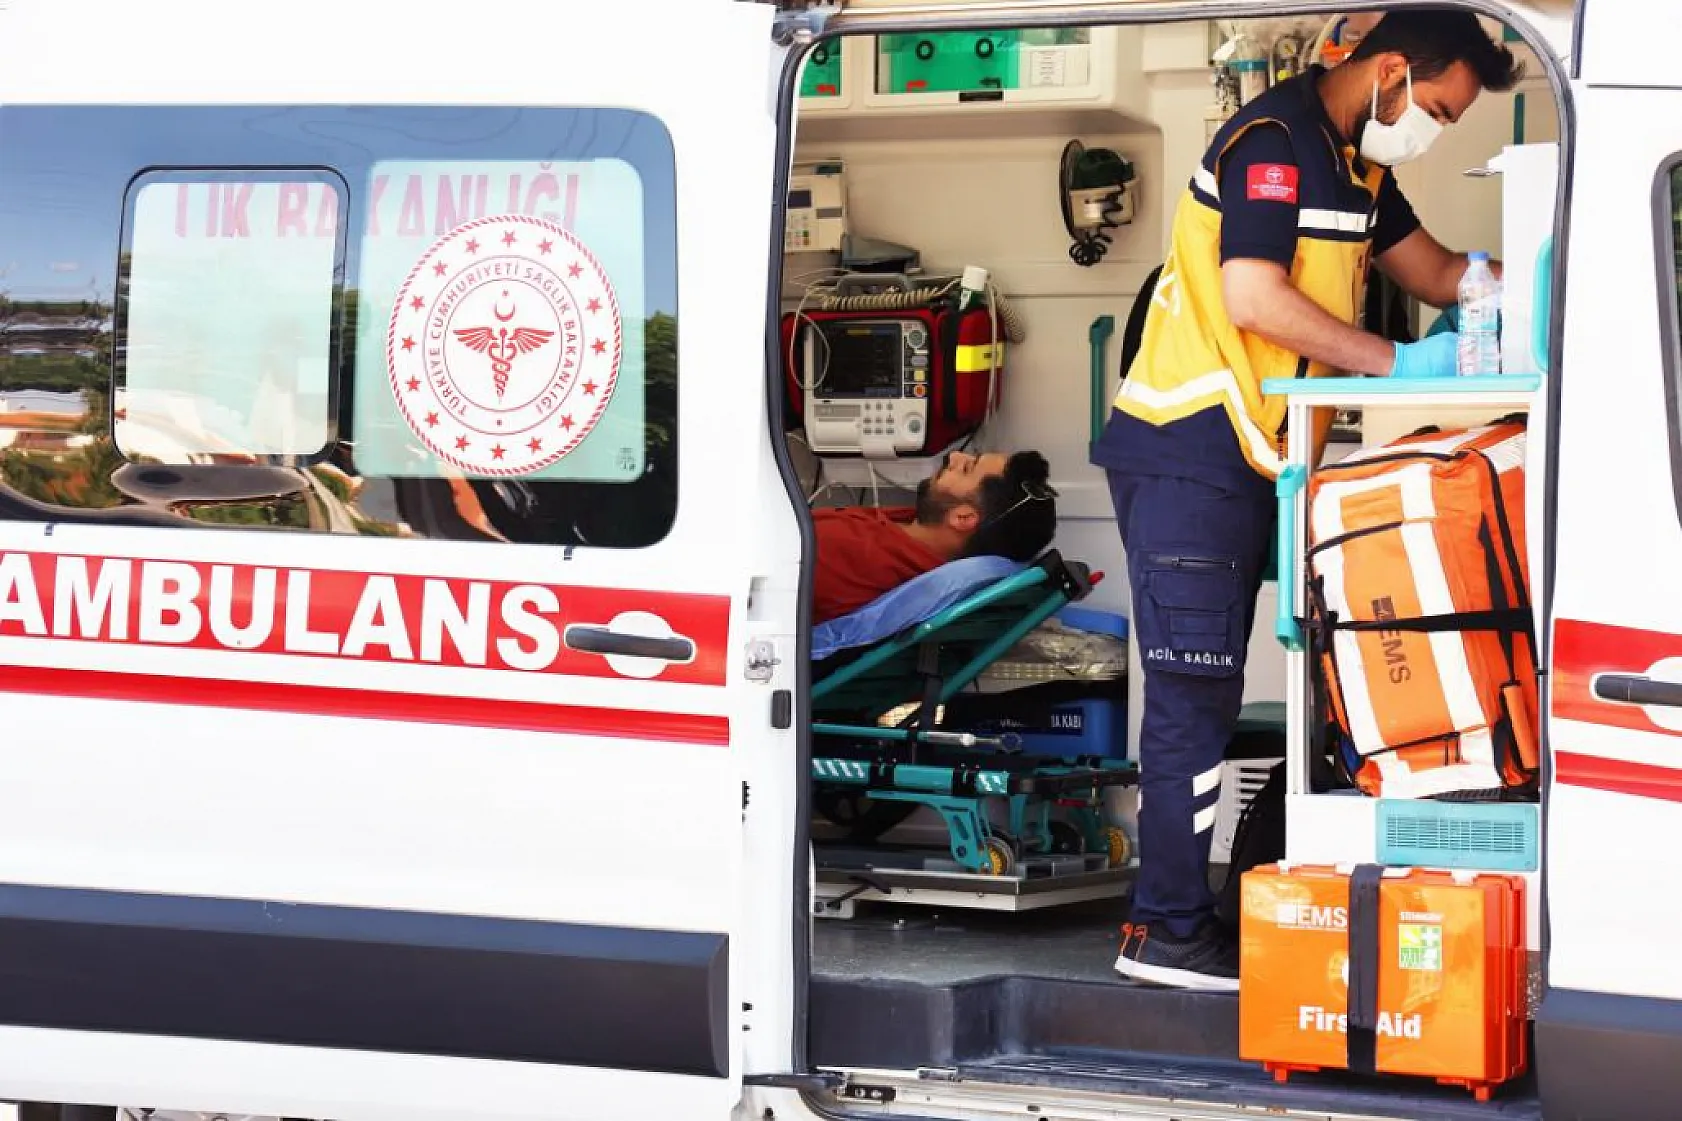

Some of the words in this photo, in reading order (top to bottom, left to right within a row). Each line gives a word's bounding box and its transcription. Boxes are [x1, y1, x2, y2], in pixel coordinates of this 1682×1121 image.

[431, 261, 520, 340] CUMHURİYETİ
[525, 267, 571, 318] SAĞLIK
[535, 320, 578, 415] BAKANLIĞI
[0, 552, 561, 671] AMBULANS
[1147, 647, 1177, 661] ACİL
[1184, 651, 1233, 667] SAĞLIK
[1297, 905, 1348, 928] EMS
[1298, 1005, 1348, 1032] Firs
[1377, 1010, 1422, 1039] Aid
